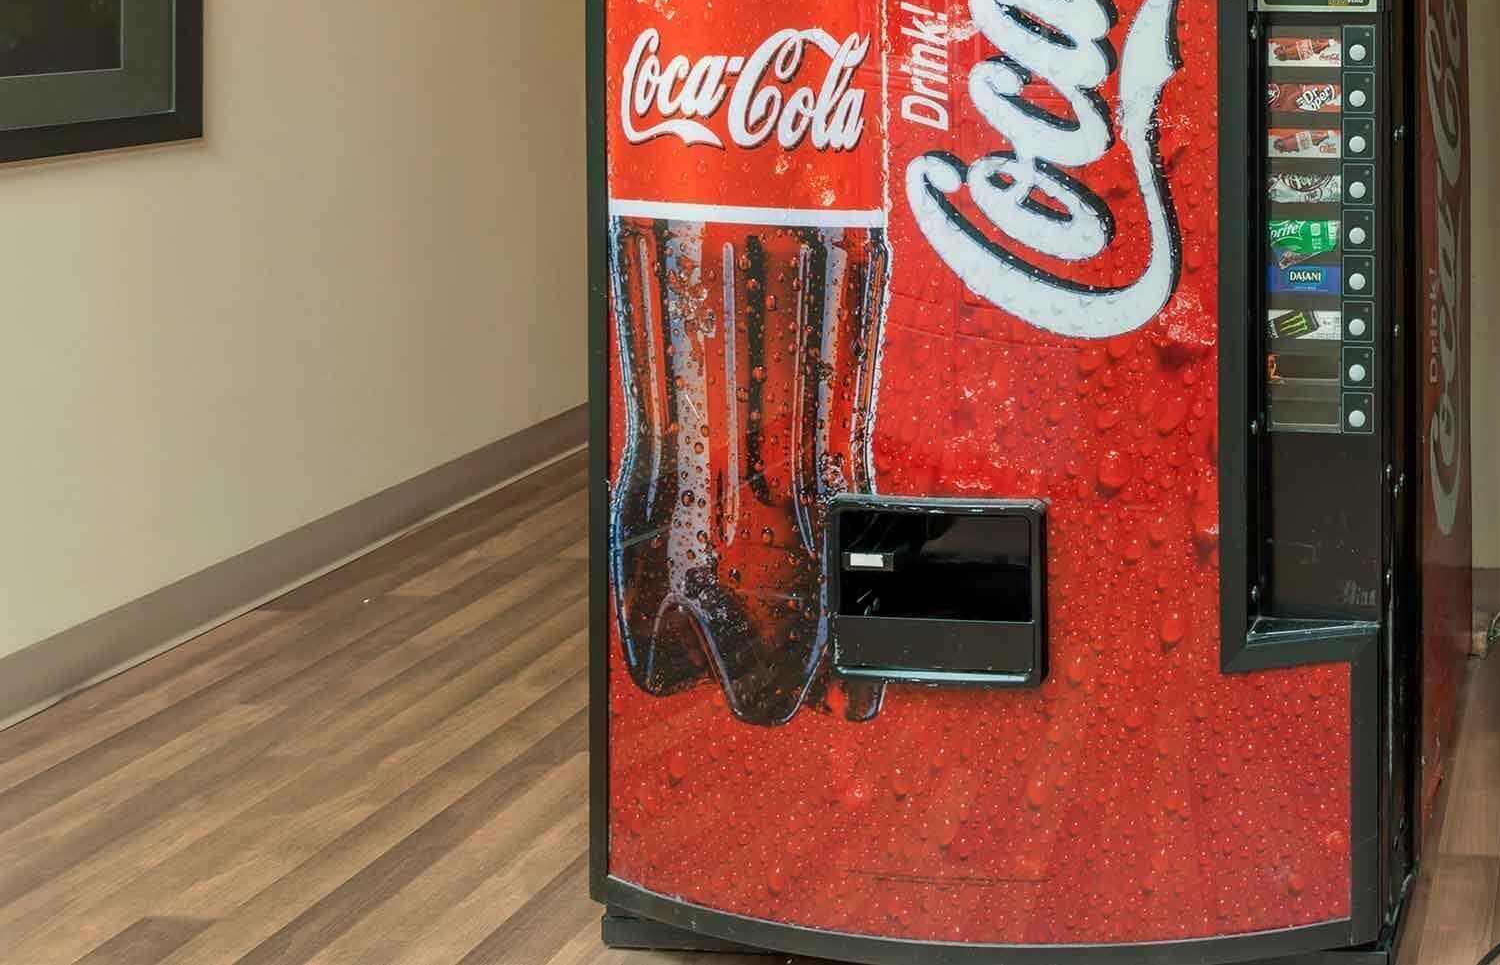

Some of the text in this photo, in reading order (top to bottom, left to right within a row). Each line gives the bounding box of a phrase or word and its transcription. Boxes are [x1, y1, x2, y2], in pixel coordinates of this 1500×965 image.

[621, 27, 871, 150] Coca-Cola
[900, 1, 949, 131] Drink!
[1289, 271, 1322, 282] DASANI
[1428, 267, 1441, 385] Drink!
